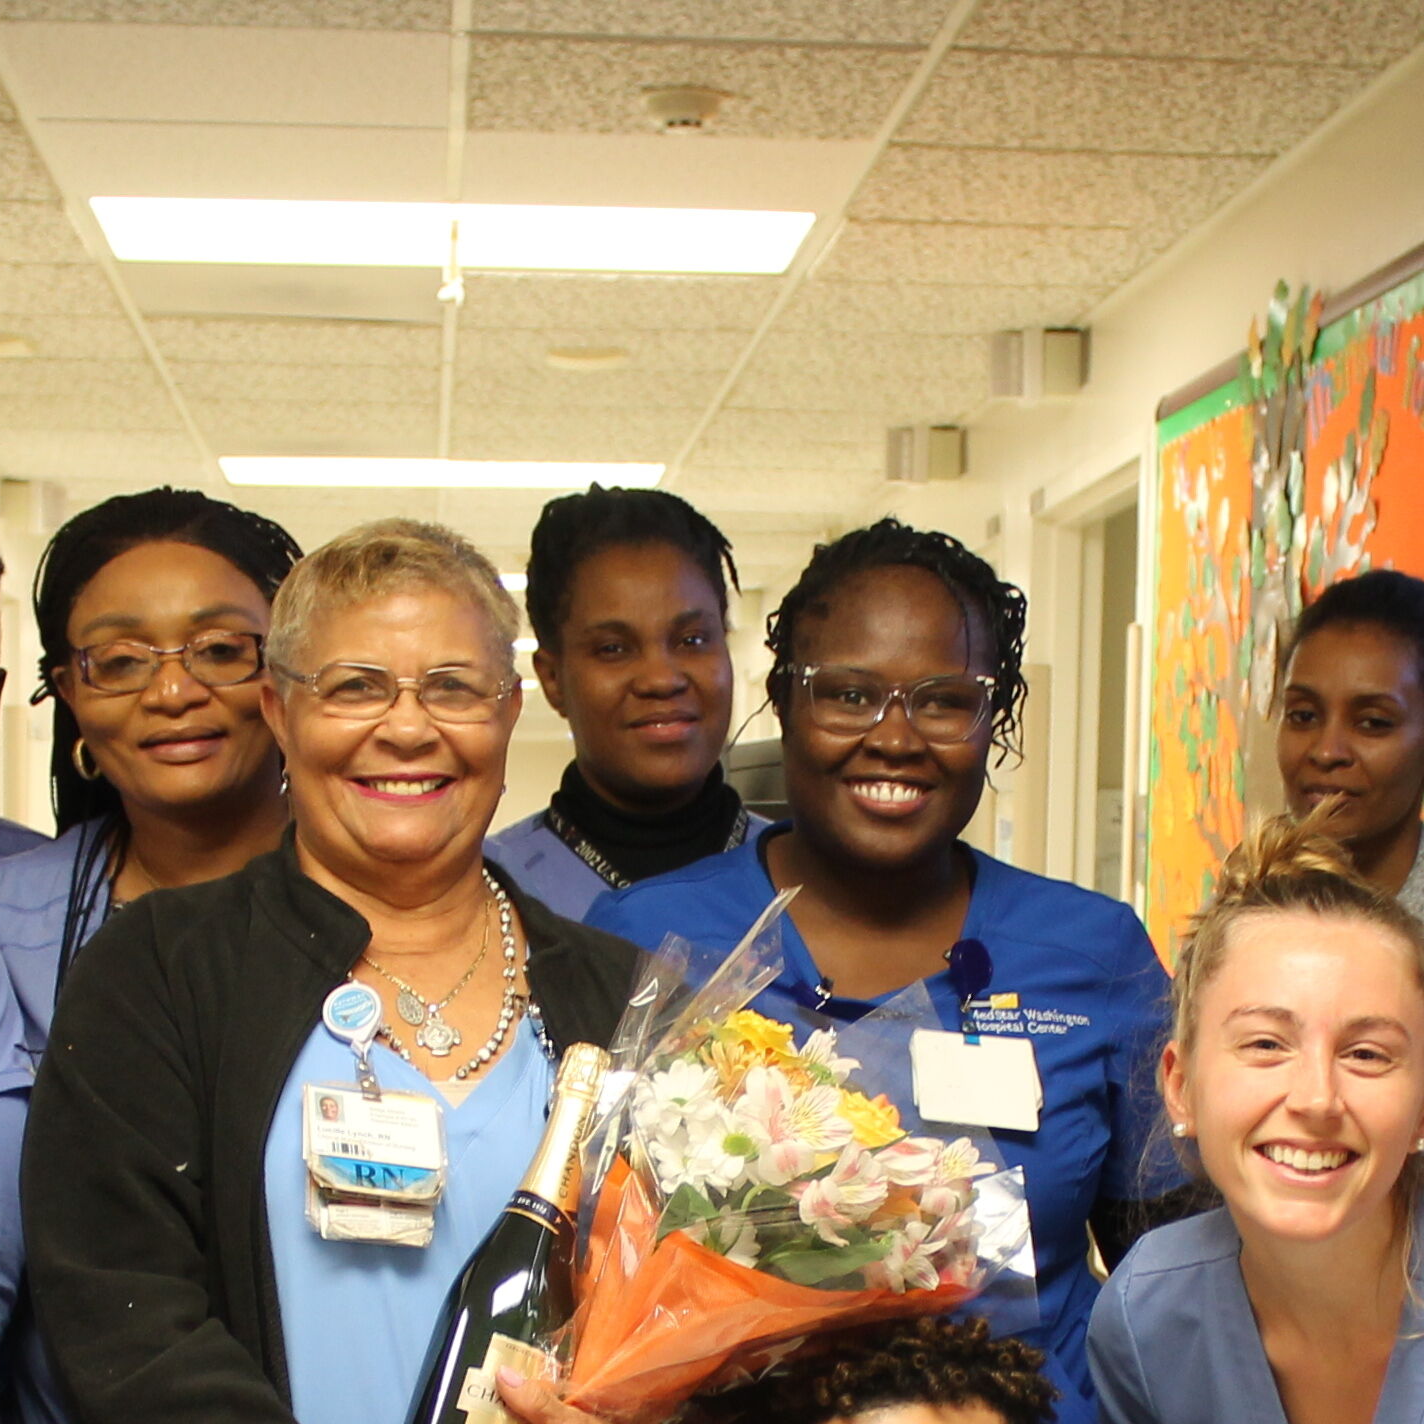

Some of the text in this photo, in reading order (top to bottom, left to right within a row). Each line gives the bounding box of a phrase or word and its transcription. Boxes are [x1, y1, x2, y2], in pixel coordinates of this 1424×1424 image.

[575, 840, 602, 867] 2002
[1023, 1008, 1092, 1028] Washington
[1027, 1021, 1069, 1034] Center
[557, 1116, 587, 1200] CHANDON
[354, 1163, 406, 1190] RN
